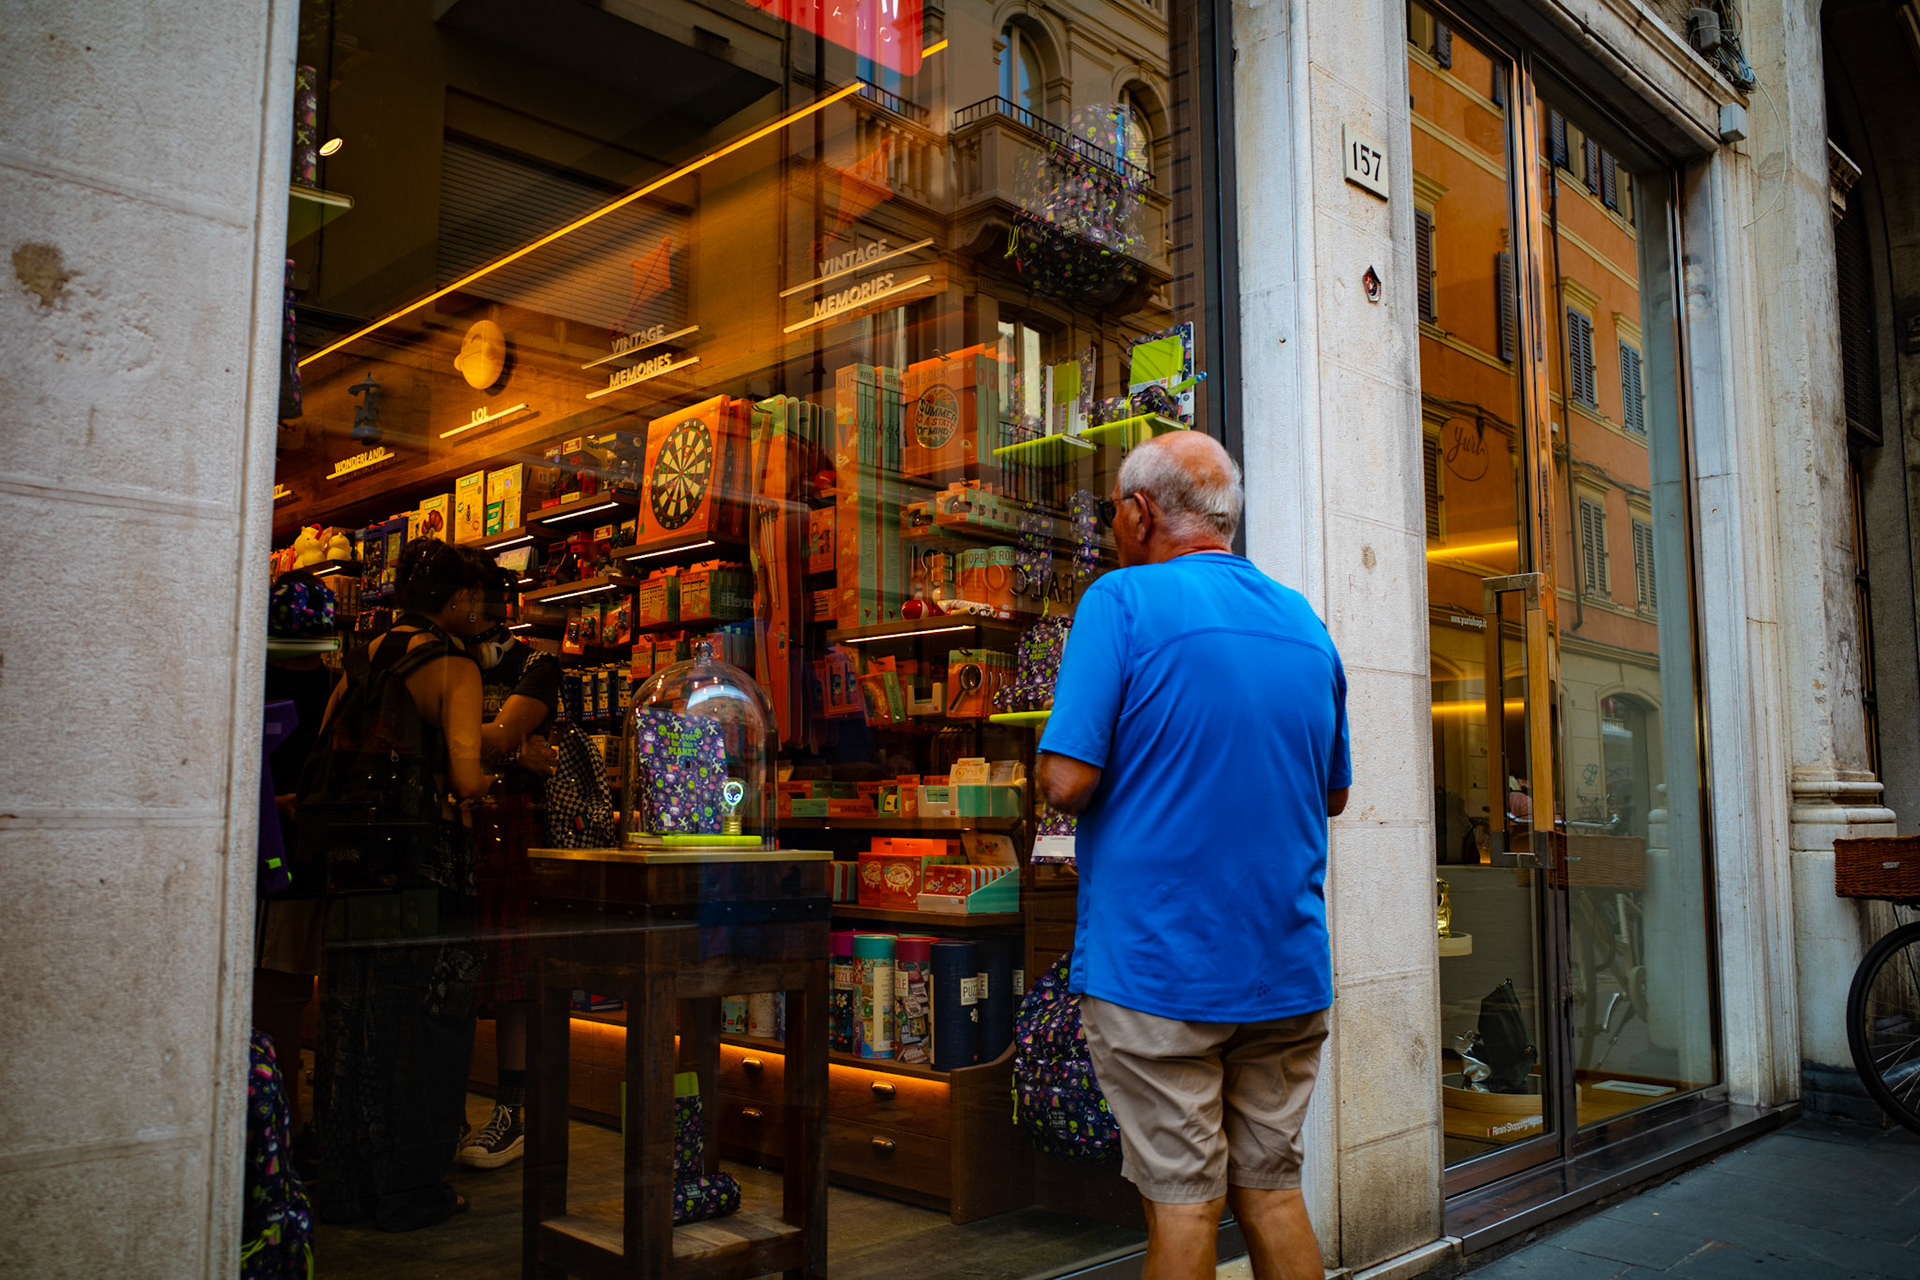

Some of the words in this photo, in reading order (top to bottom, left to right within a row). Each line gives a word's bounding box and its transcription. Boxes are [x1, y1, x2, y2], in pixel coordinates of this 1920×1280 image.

[1352, 141, 1382, 182] 157
[818, 239, 887, 278] VINTAGE
[814, 273, 894, 317] MEMORIES
[610, 323, 665, 354] VINTAGE
[609, 353, 673, 388] MEMORIES
[860, 371, 873, 382] KITE
[884, 373, 897, 385] KITE
[471, 406, 488, 424] LOL
[919, 398, 958, 423] SUMMER
[917, 426, 927, 436] OF
[334, 446, 386, 474] WONDERLAND
[666, 731, 679, 740] TOO
[667, 746, 698, 757] PLANET
